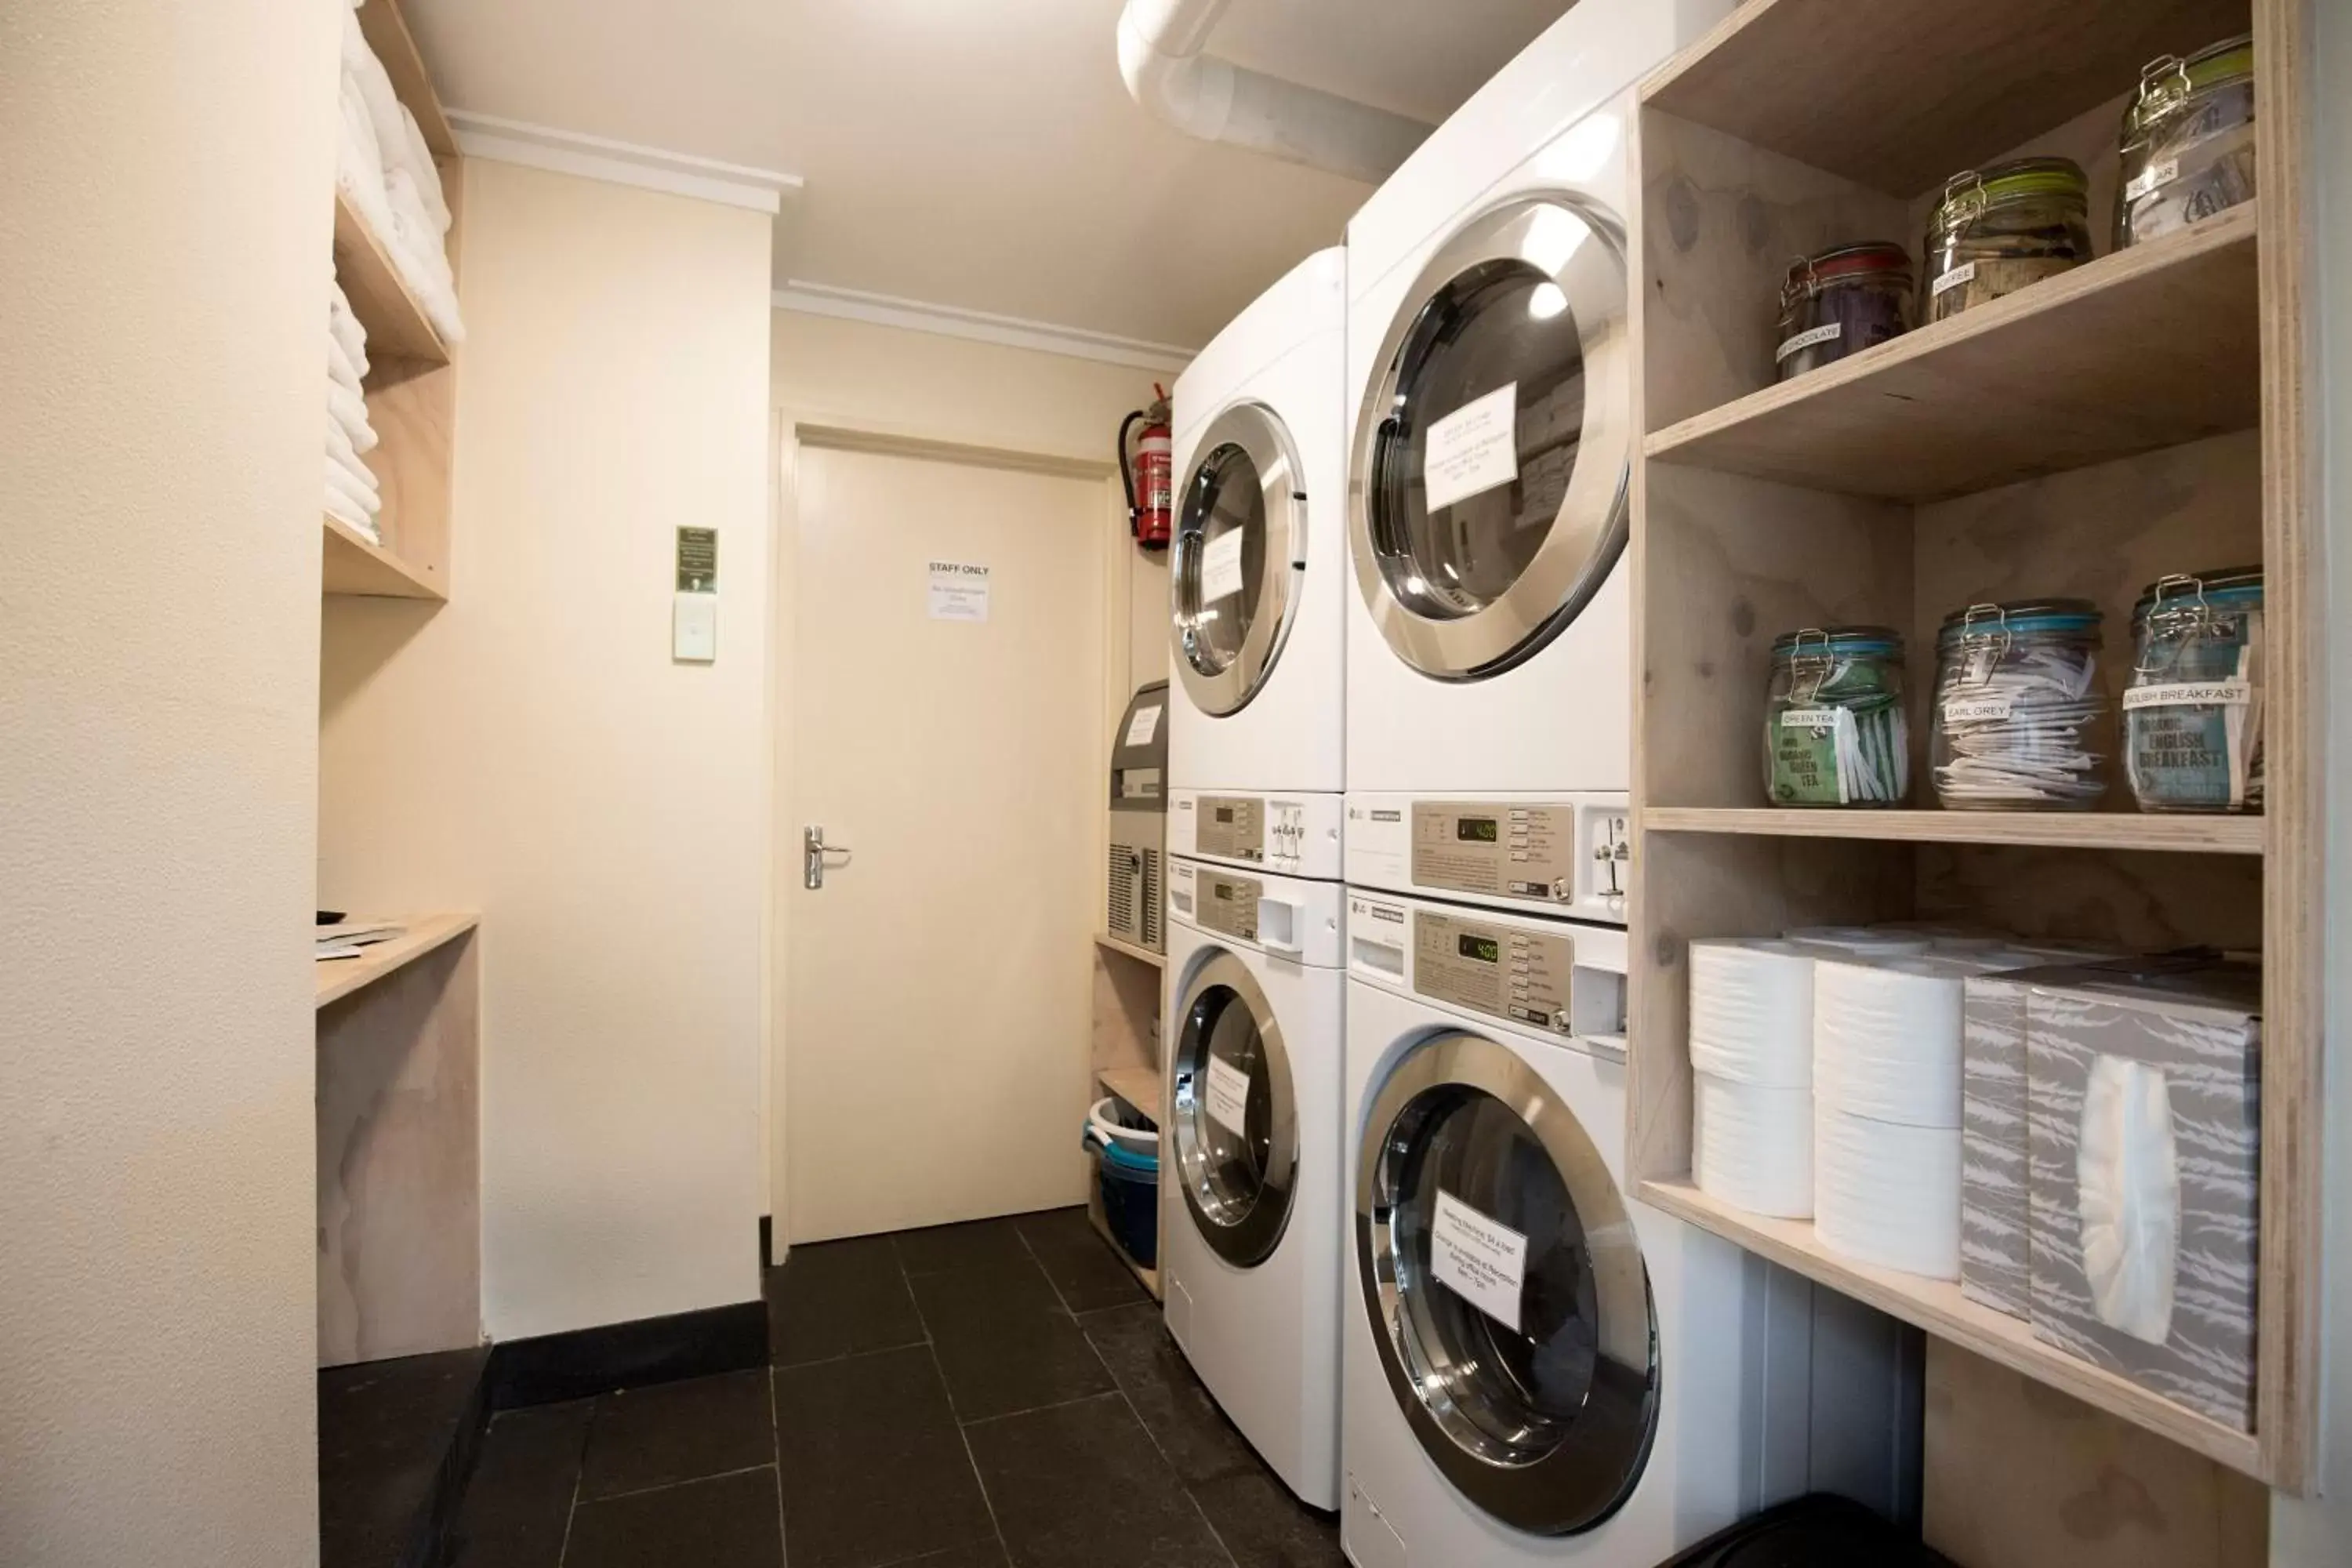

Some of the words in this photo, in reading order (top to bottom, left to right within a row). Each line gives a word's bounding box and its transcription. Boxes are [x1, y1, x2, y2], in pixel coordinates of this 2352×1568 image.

[929, 562, 960, 573] STAFF
[962, 564, 989, 575] ONLY
[2160, 688, 2245, 700] BREAKFAST
[1947, 708, 1971, 717] EARL
[1974, 706, 2006, 717] GREY
[1784, 713, 1813, 723] GREEN
[1816, 713, 1834, 723] TEA
[2150, 732, 2205, 750] ENGLISH
[2139, 749, 2222, 768] BREAKFAST
